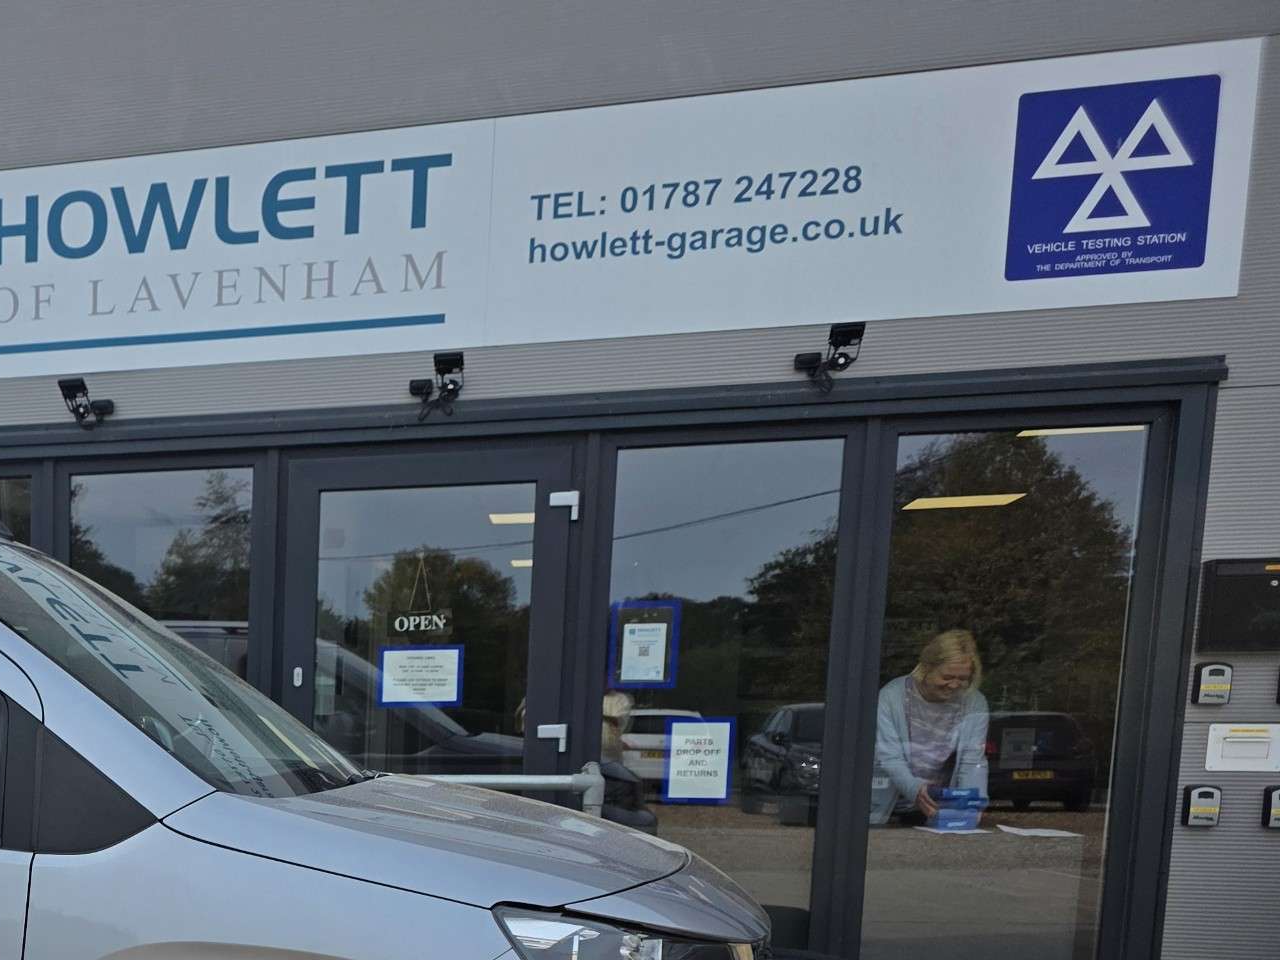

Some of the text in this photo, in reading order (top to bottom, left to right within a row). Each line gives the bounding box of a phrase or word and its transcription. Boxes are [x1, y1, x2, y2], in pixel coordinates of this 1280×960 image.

[530, 165, 863, 221] TEL: 01787 247228
[528, 207, 904, 263] howlett-garage.co.uk
[1027, 232, 1187, 254] VEHICLE TESTING STATION
[1036, 264, 1051, 272] THE
[1055, 260, 1106, 271] DEPARTMENT
[1125, 255, 1173, 265] TRANSPORT
[1075, 250, 1133, 262] APPROVED BY
[88, 250, 448, 317] LAVENHAM
[394, 614, 447, 631] OPEN
[684, 738, 714, 746] PARTS
[676, 769, 719, 777] RETURNS
